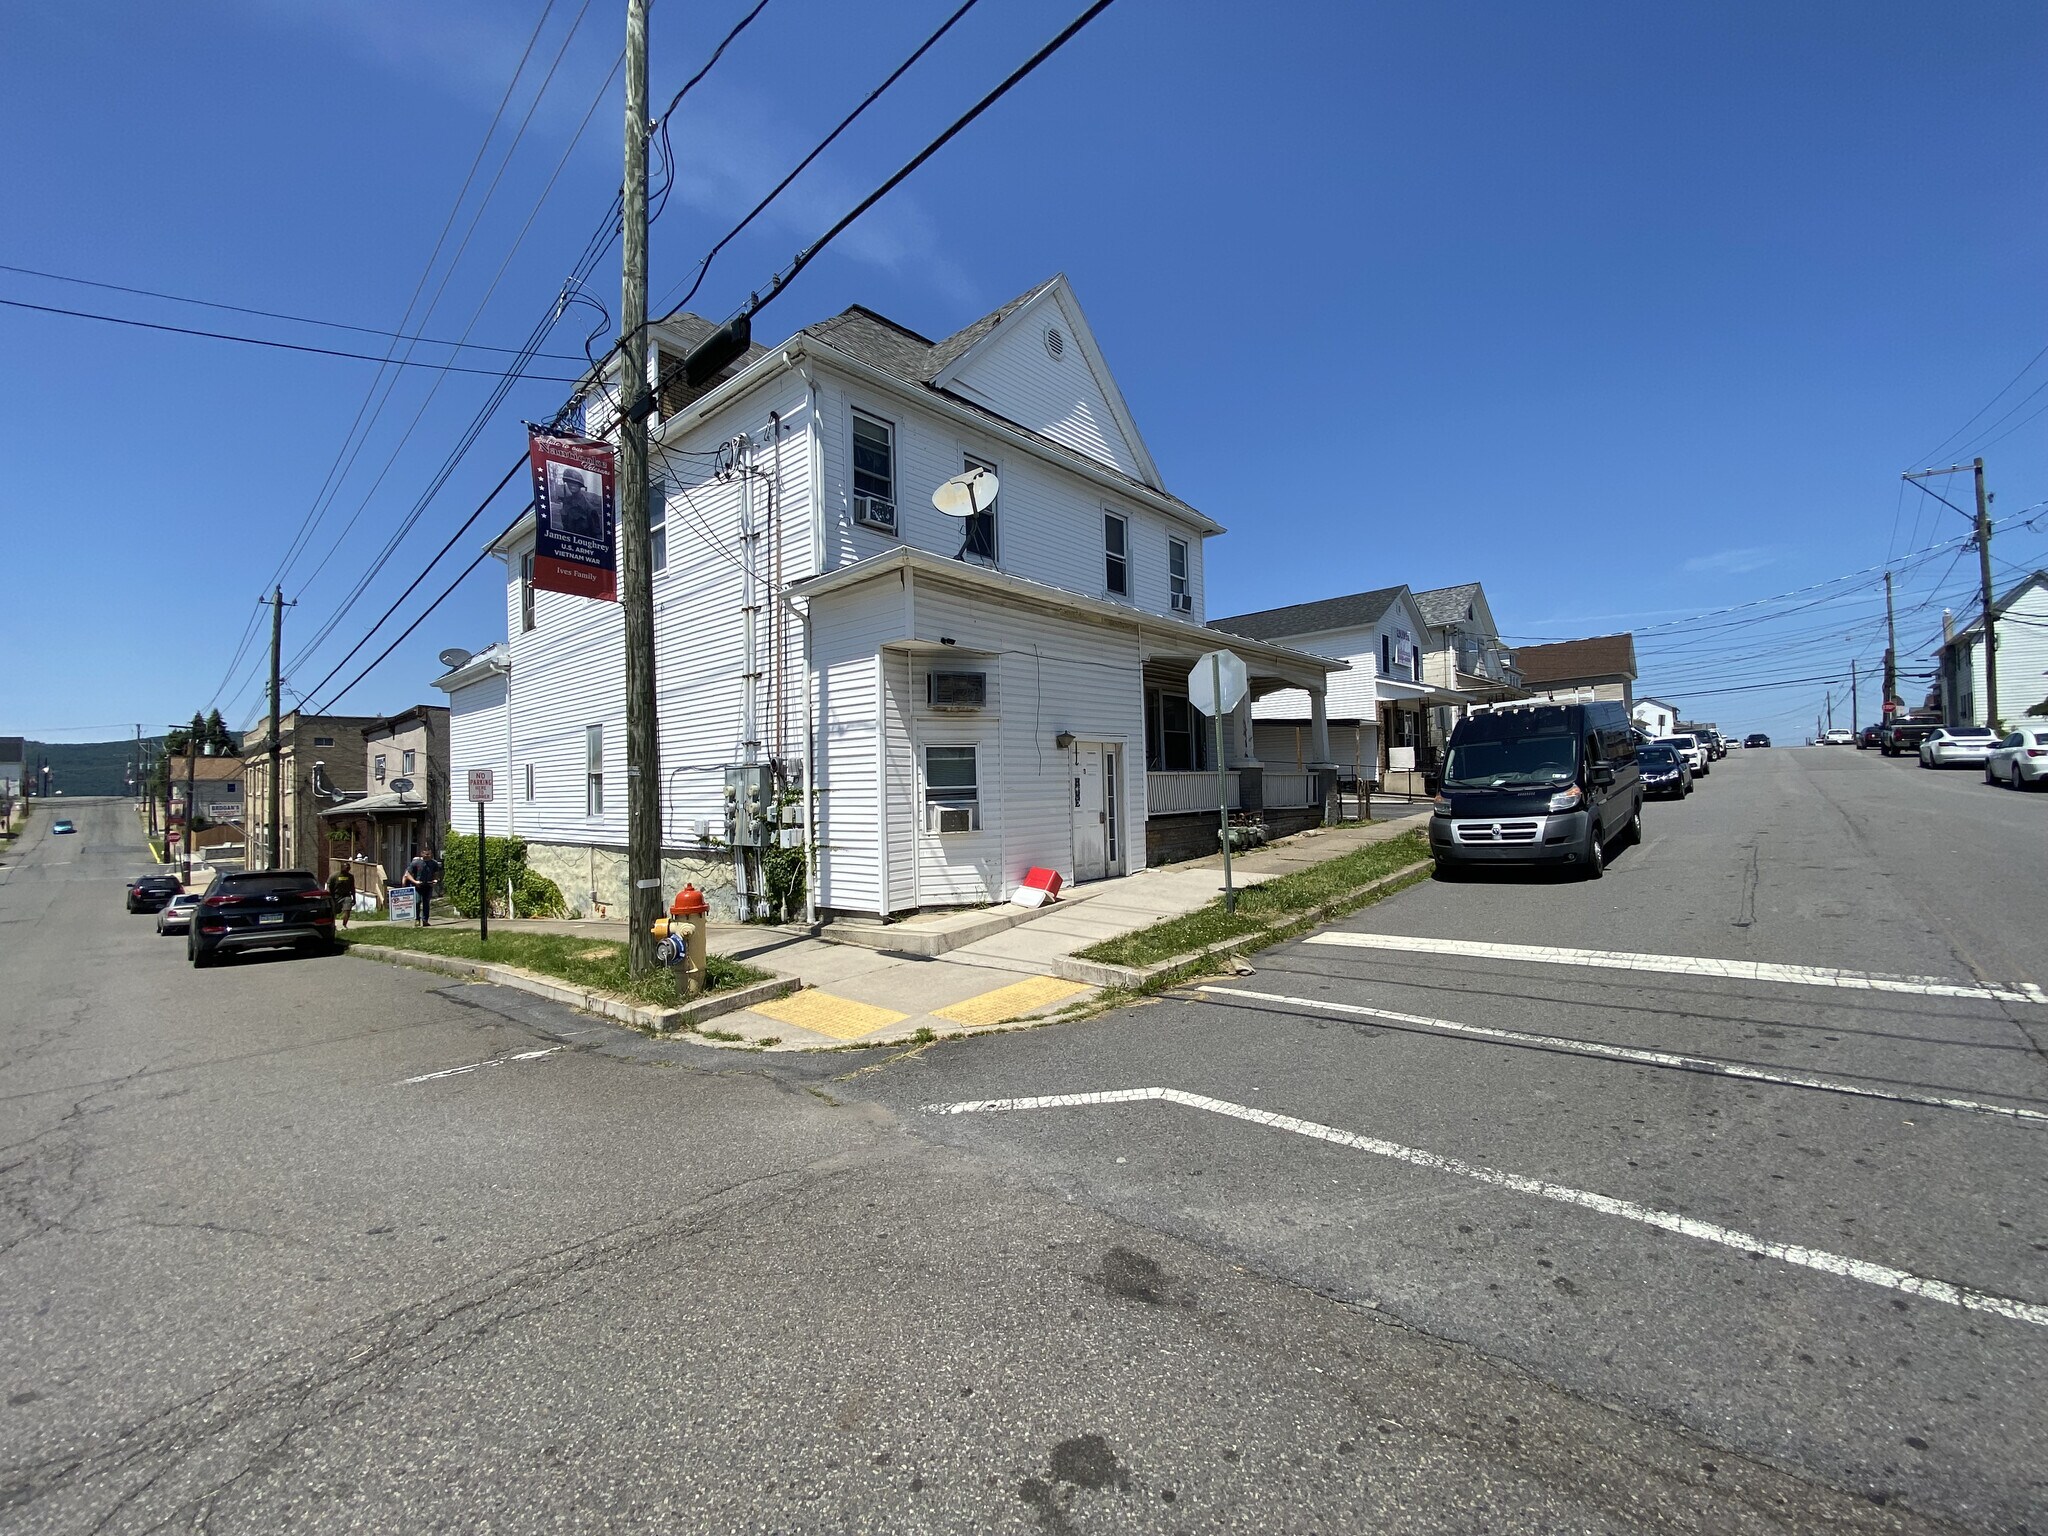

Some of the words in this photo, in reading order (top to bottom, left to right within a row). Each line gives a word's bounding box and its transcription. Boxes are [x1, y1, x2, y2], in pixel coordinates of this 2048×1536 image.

[544, 529, 571, 542] James
[573, 536, 609, 553] Loughrey
[554, 549, 584, 561] VIETNAM
[585, 556, 601, 565] WAR
[561, 543, 574, 552] U.S.
[575, 546, 594, 556] ARMY
[557, 567, 572, 576] Ives
[573, 570, 597, 581] Family
